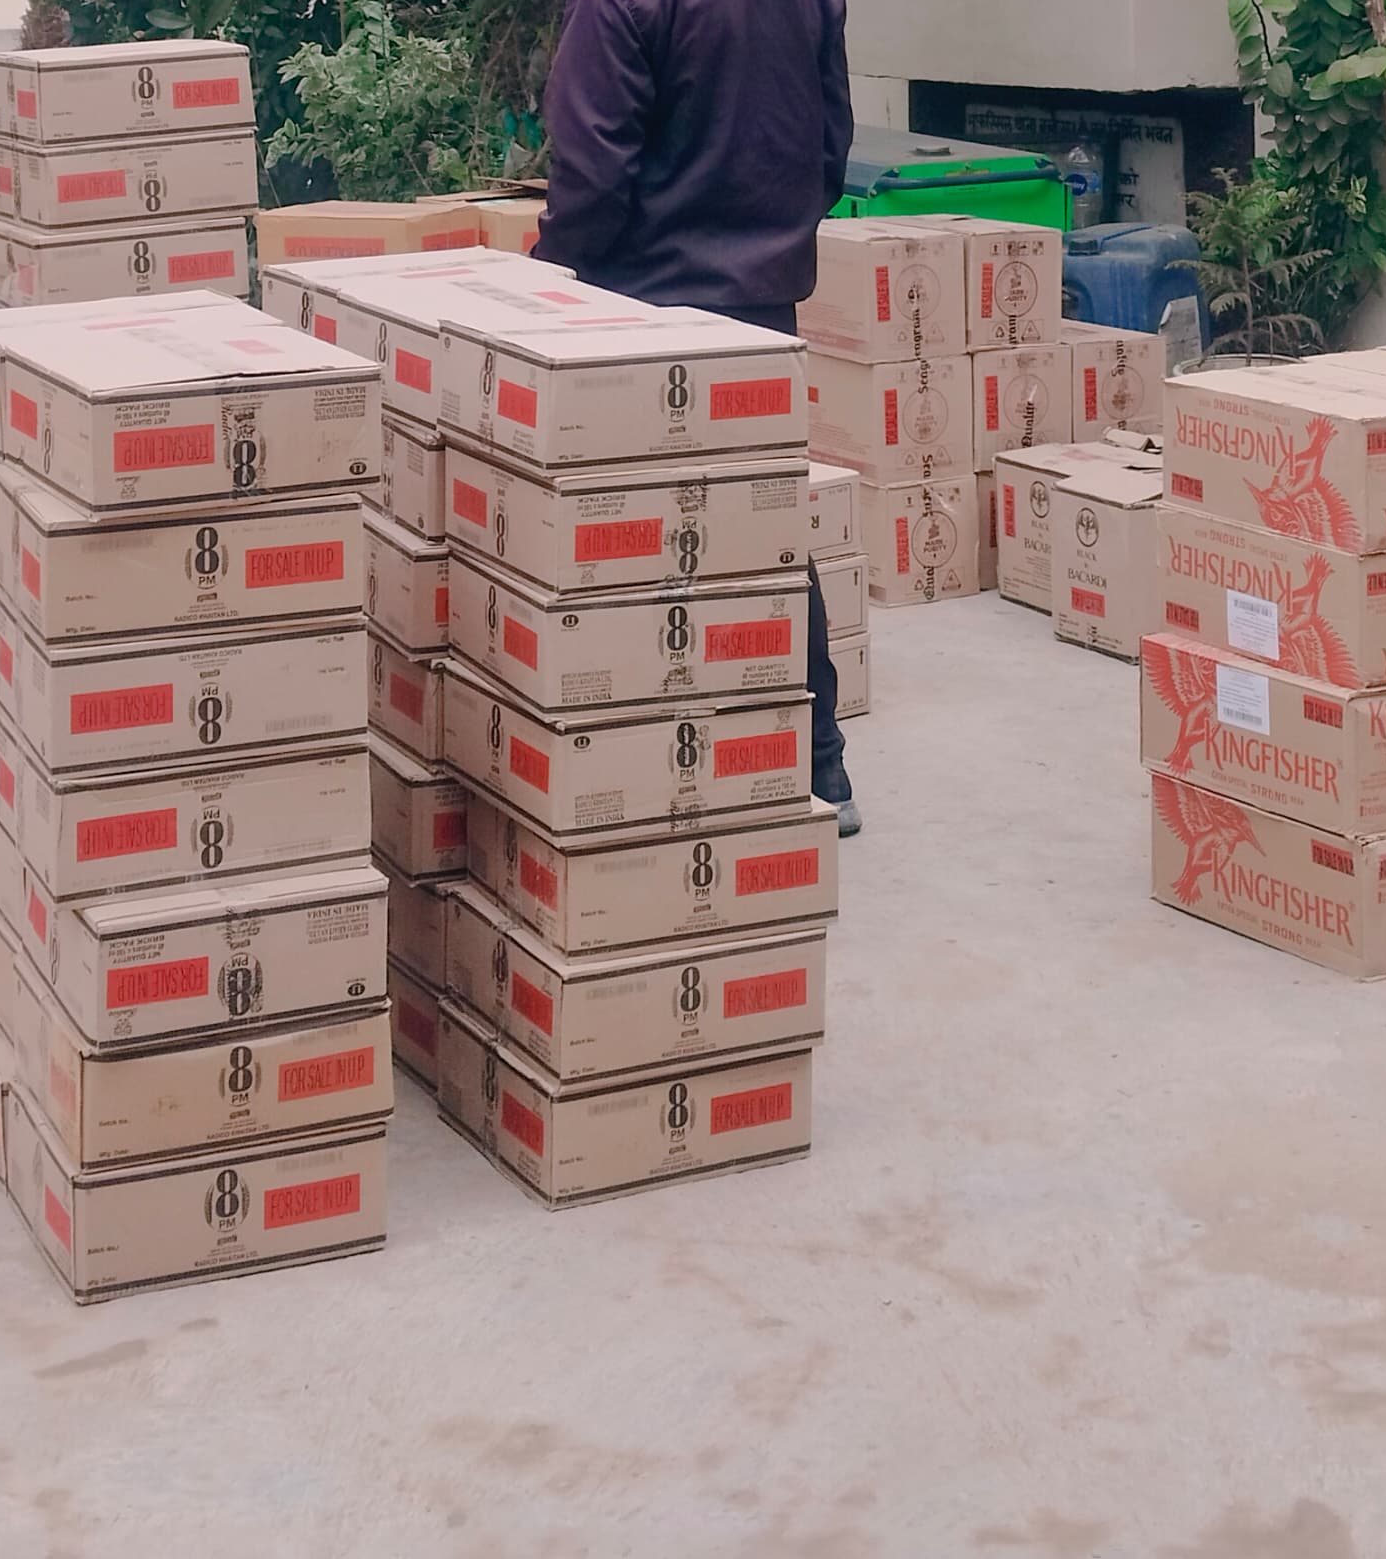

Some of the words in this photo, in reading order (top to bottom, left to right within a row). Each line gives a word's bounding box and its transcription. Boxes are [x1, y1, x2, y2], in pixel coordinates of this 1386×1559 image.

[137, 67, 155, 99] 8
[144, 179, 161, 212] 8
[133, 241, 151, 274] 8
[667, 364, 688, 409] 8
[670, 409, 685, 419] PM
[1175, 405, 1296, 478] KINGFISHER
[195, 526, 220, 575] 8
[198, 575, 216, 586] PM
[1068, 567, 1108, 590] BACARDI
[667, 605, 689, 651] 8
[669, 651, 685, 661] PM
[201, 686, 219, 697] PM
[198, 697, 222, 745] 8
[679, 768, 695, 778] PM
[1204, 717, 1340, 803] KINGFISHER
[1251, 783, 1288, 805] STRONG
[203, 810, 220, 821] PM
[199, 820, 225, 869] 8
[692, 842, 713, 887] 8
[695, 888, 710, 898] PM
[1213, 849, 1354, 946] KINGFISHER
[1261, 919, 1303, 945] STRONG
[231, 956, 249, 968] PM
[227, 967, 253, 1017] 8
[680, 966, 701, 1012] 8
[683, 1012, 698, 1023] PM
[228, 1045, 253, 1093] 8
[231, 1093, 249, 1104] PM
[667, 1082, 689, 1129] 8
[670, 1129, 685, 1139] PM
[215, 1169, 240, 1218] 8
[218, 1218, 236, 1230] PM
